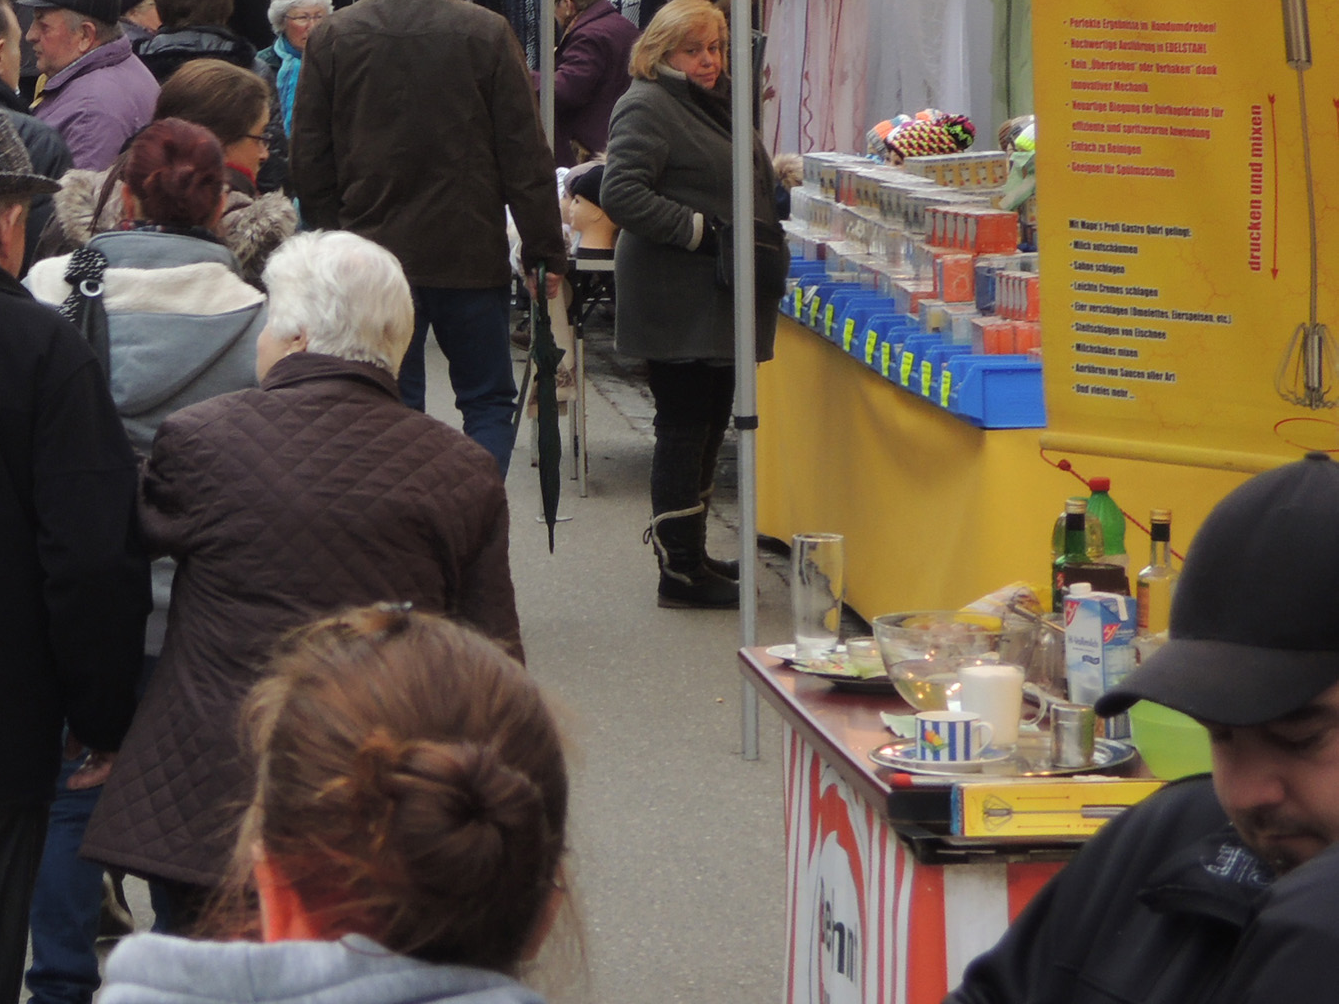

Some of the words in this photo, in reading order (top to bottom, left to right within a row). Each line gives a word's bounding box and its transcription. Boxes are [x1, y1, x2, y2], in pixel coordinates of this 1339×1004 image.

[1249, 105, 1262, 158] mixen
[1248, 162, 1262, 195] und
[1121, 223, 1145, 234] Gastro
[1146, 224, 1163, 236] Quirl
[1247, 199, 1262, 272] drucken
[1125, 286, 1158, 298] schlagen
